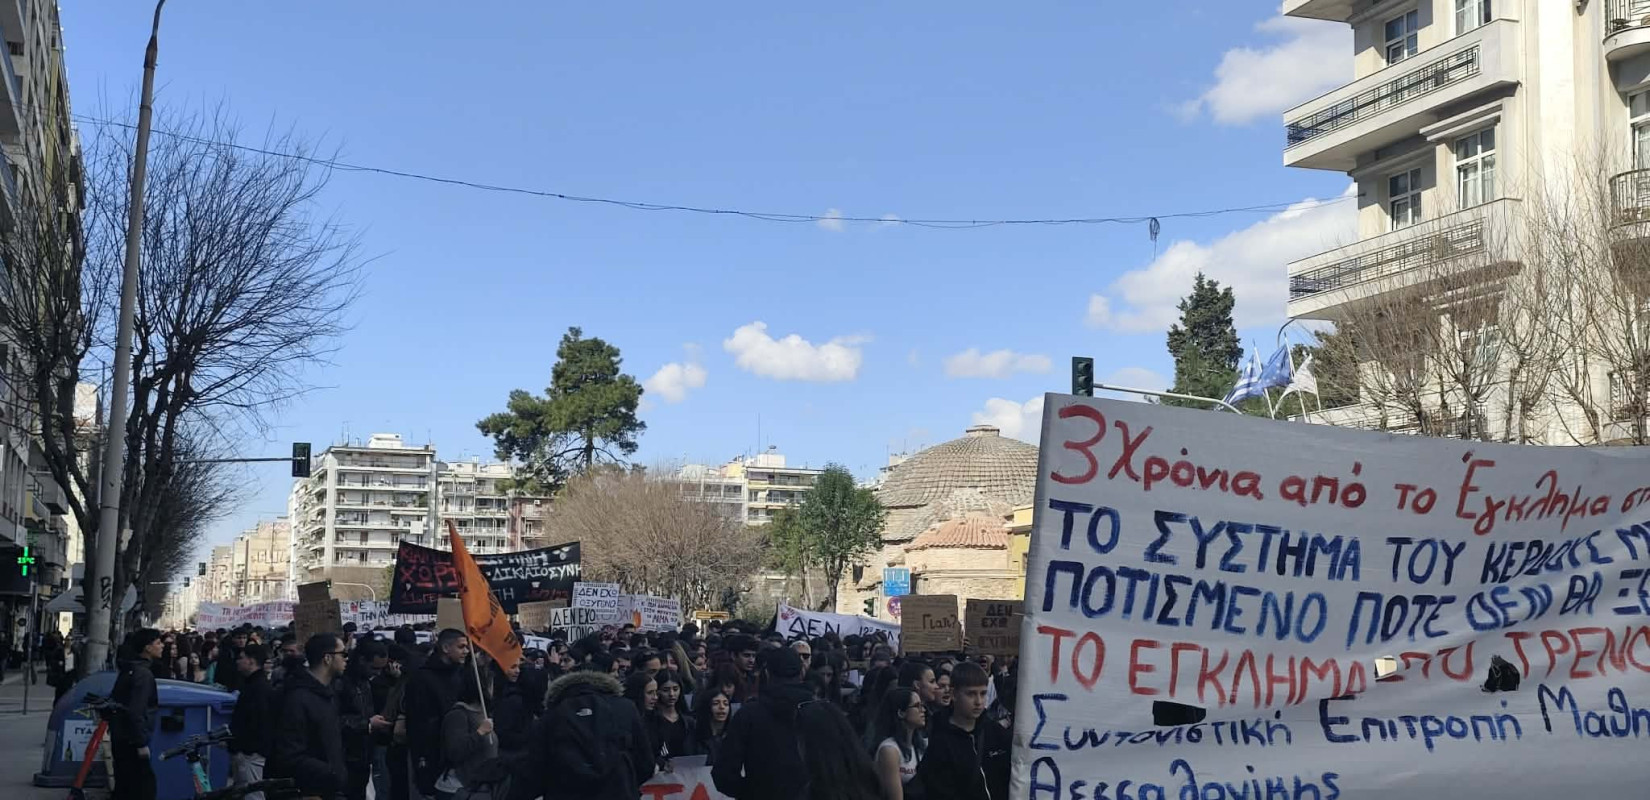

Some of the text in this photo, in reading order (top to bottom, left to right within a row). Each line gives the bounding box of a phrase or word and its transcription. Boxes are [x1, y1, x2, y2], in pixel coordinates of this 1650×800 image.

[1050, 403, 1107, 485] 3
[1107, 420, 1264, 501] Χρόνια
[1279, 461, 1367, 507] από
[1394, 483, 1438, 514] το
[1456, 451, 1612, 535] Έγκλημα
[1049, 498, 1121, 554] ΤΟ
[1144, 509, 1361, 581] ΣΥΣΤΗΜΑ
[1386, 536, 1467, 586] ΤΟΥ
[553, 609, 577, 626] ΔΕΝ
[578, 588, 598, 597] ΔΕΝ
[1042, 561, 1328, 644] ΠΟΤΙΣΜΕΝΟ
[1346, 591, 1457, 650] ΠΟΤΕ
[1559, 571, 1603, 616] ΘΑ
[1037, 624, 1106, 692] ΤΟ
[1128, 638, 1367, 708] ΕΓΚΛΗΜΑ
[1029, 693, 1292, 750] Συντονιστική
[1319, 694, 1523, 753] Επιτροπή
